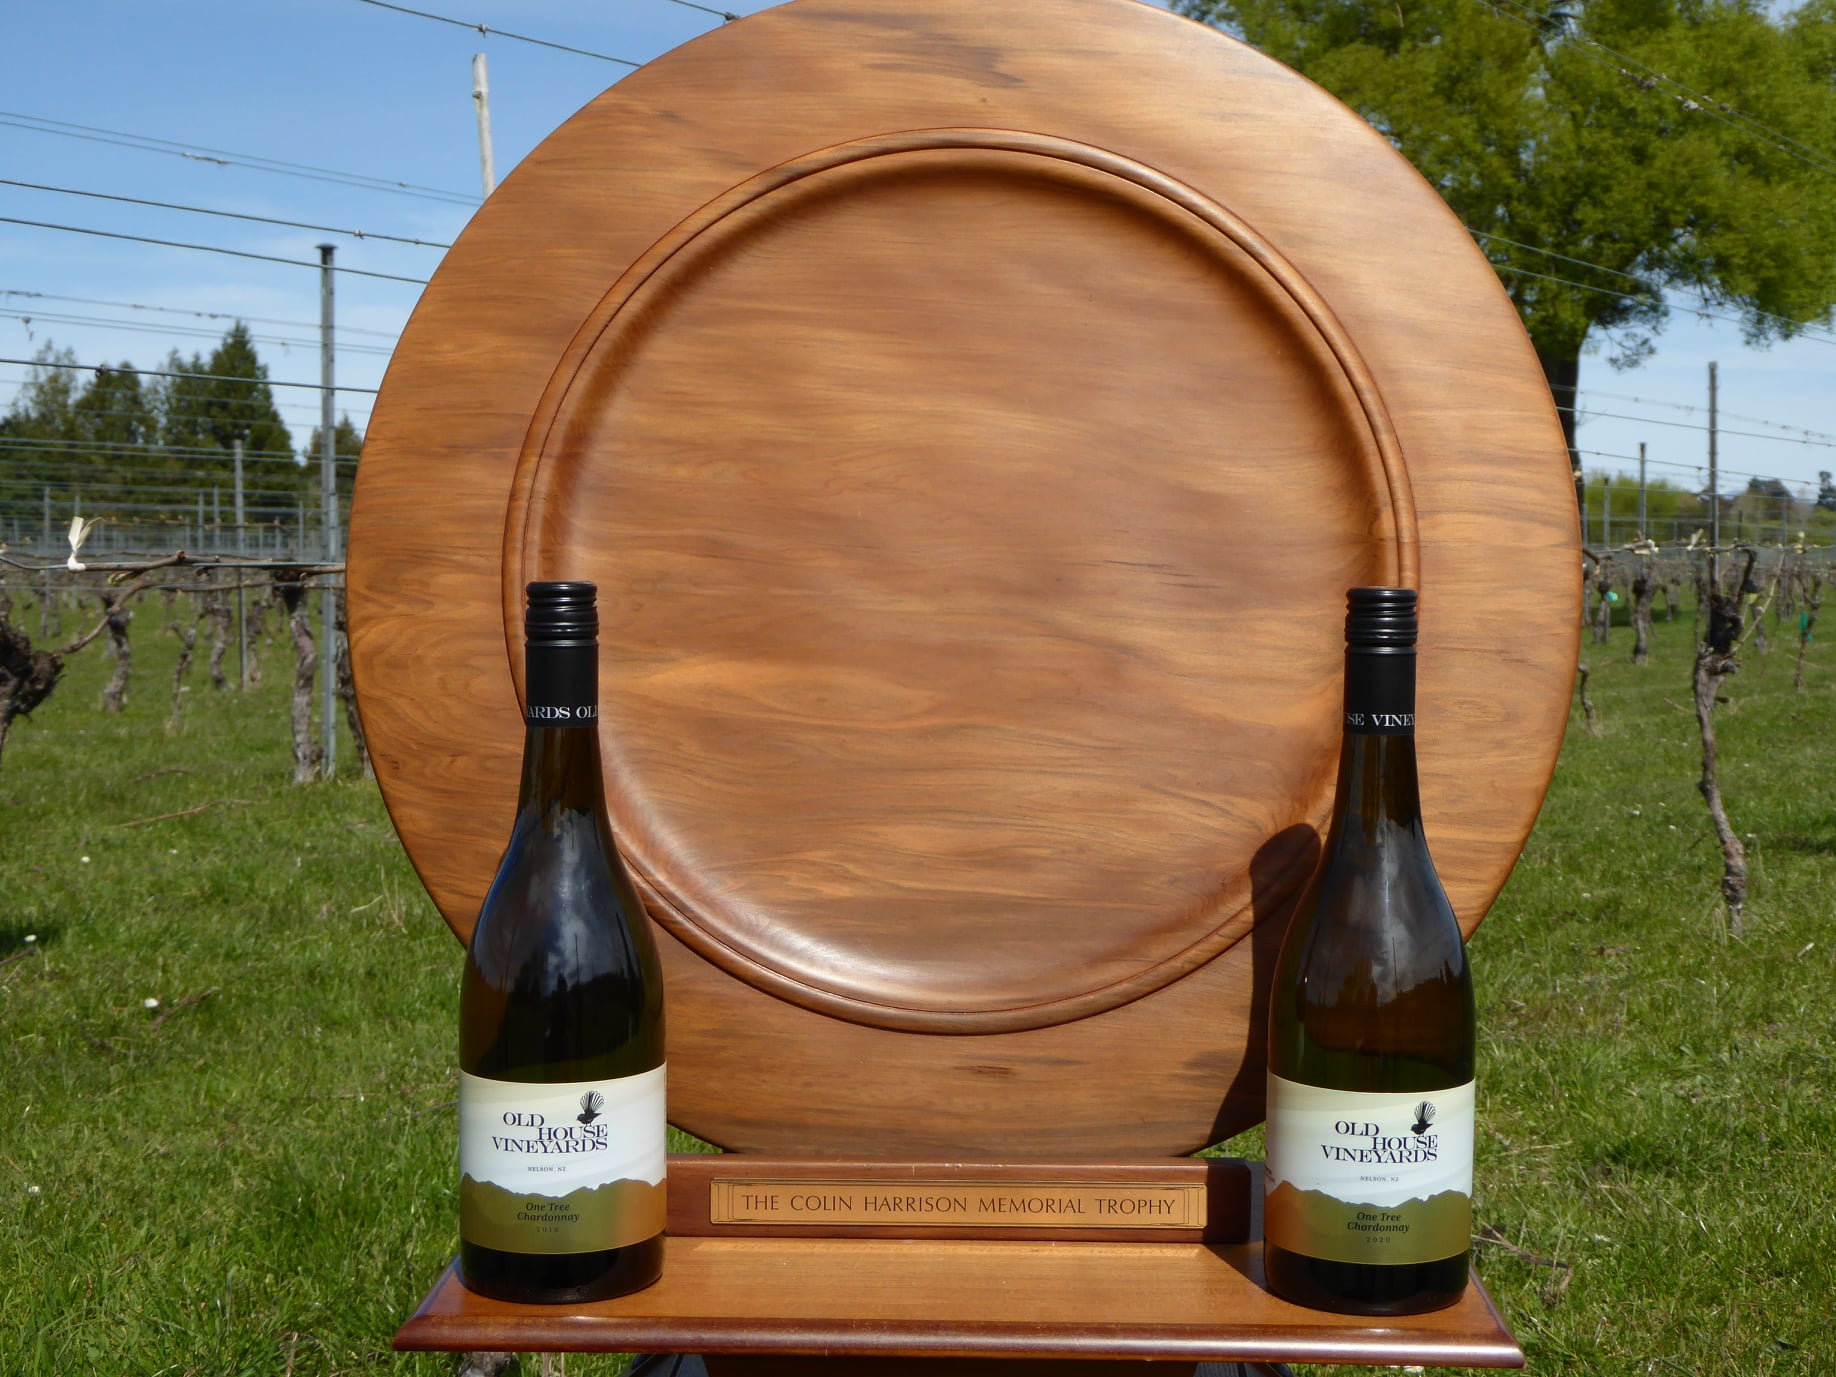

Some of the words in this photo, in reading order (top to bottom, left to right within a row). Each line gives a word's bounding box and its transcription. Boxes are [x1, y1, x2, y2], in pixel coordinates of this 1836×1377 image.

[503, 1111, 545, 1128] OLD
[537, 1124, 608, 1141] HOUSE
[1335, 1120, 1380, 1137] OLD
[491, 1136, 608, 1154] VINEYARDS
[1371, 1134, 1438, 1151] HOUSE
[1321, 1145, 1438, 1164] VINEYARDS
[525, 1202, 546, 1211] One
[548, 1202, 570, 1211] Tree
[742, 1194, 780, 1211] THE
[790, 1195, 852, 1212] COLIN
[864, 1196, 967, 1213] HARRISON
[978, 1197, 1086, 1214] MEMORIAL
[1095, 1198, 1176, 1215] TROPHY
[516, 1211, 580, 1223] Chardonnay
[1356, 1211, 1378, 1221] One
[1380, 1212, 1402, 1221] Tree
[1347, 1221, 1411, 1234] Chardonnay
